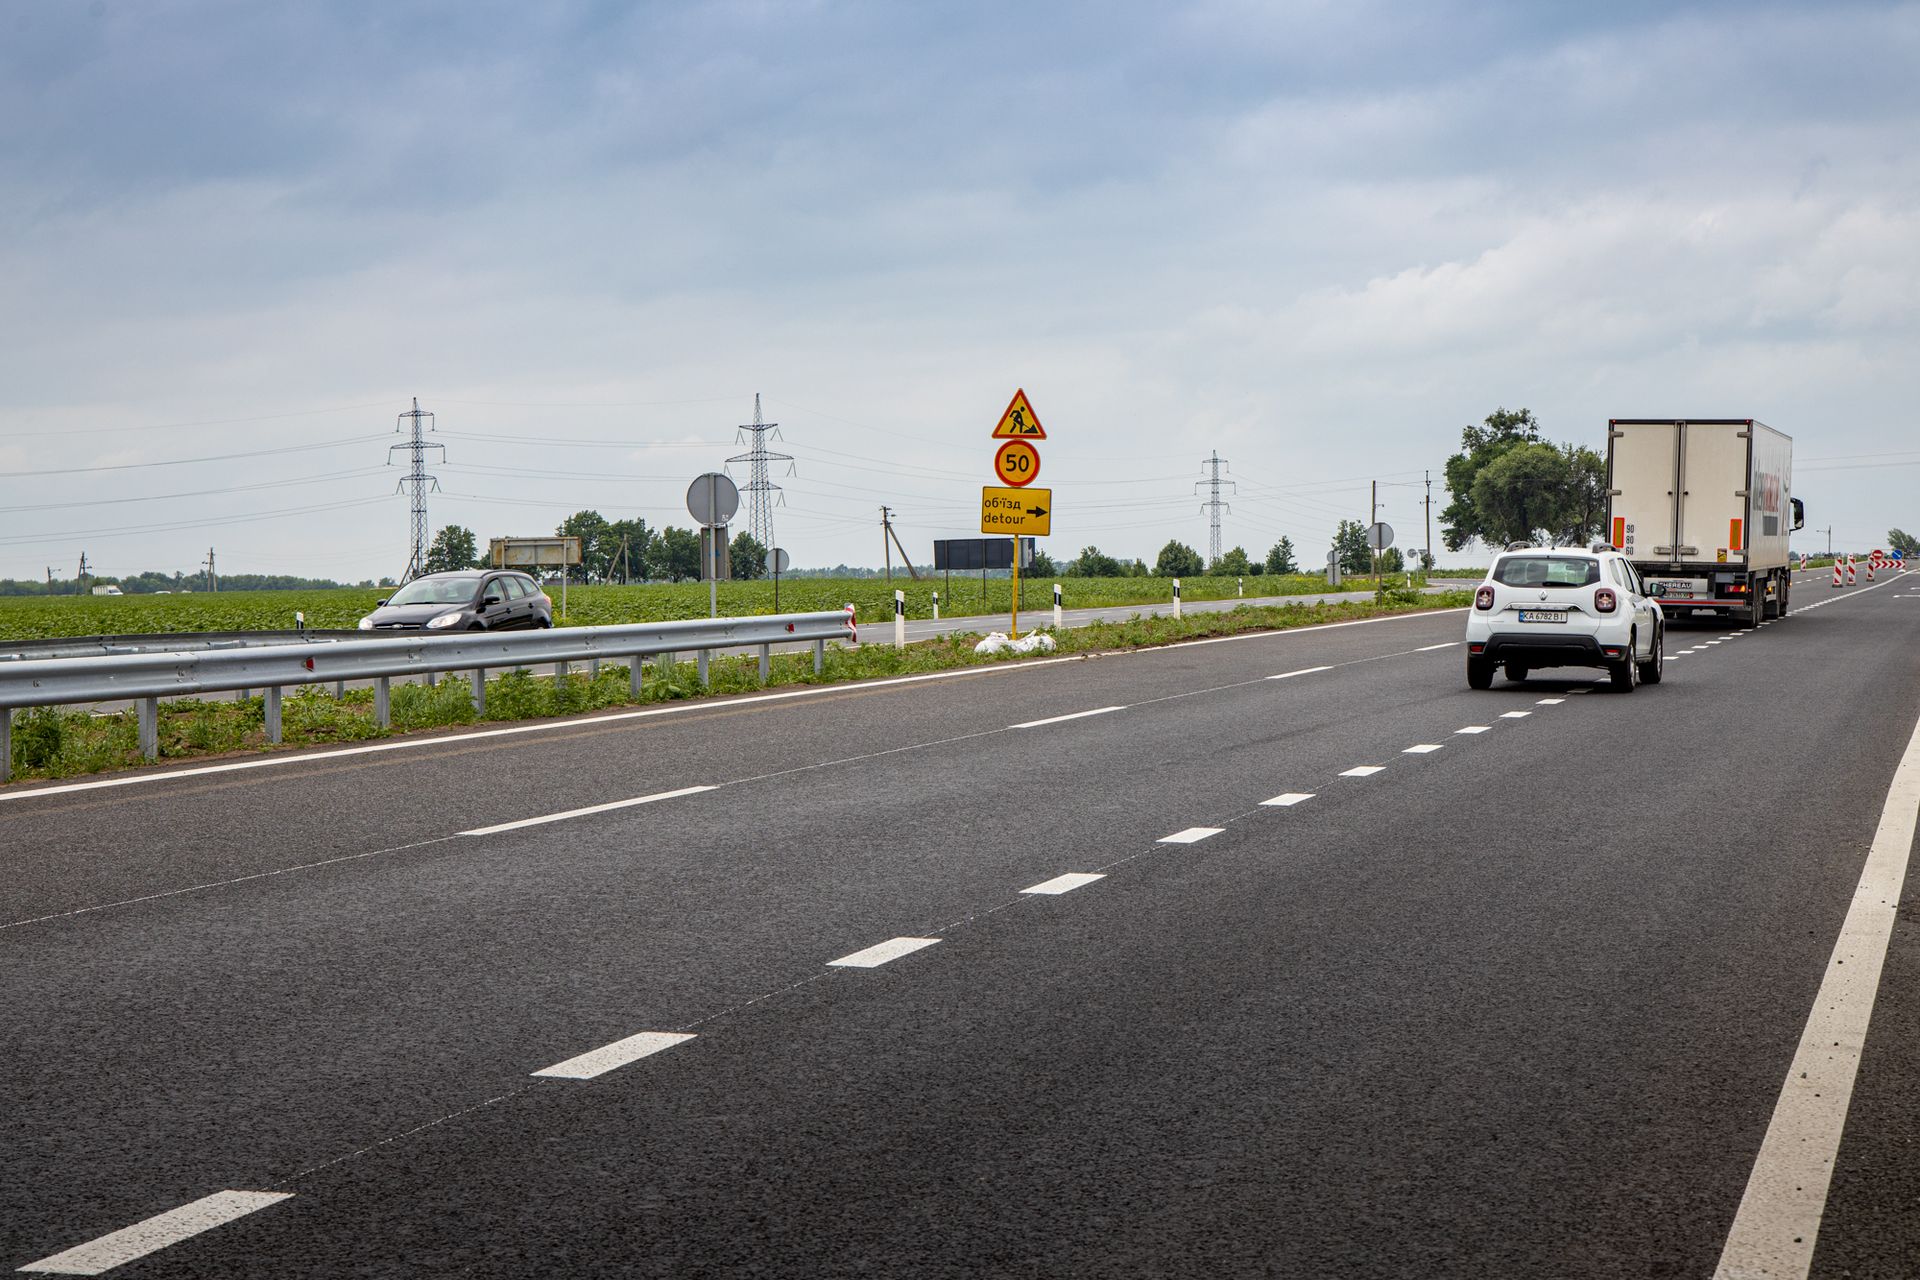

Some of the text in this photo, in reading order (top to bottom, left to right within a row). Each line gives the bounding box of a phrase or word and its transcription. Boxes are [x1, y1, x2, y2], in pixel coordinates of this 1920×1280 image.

[1006, 454, 1029, 472] 50
[984, 497, 1021, 510] об'їзд
[984, 513, 1025, 525] detour
[1626, 524, 1634, 534] 90
[1626, 535, 1634, 544] 80
[1625, 546, 1634, 555] 60
[1524, 612, 1534, 620] KA
